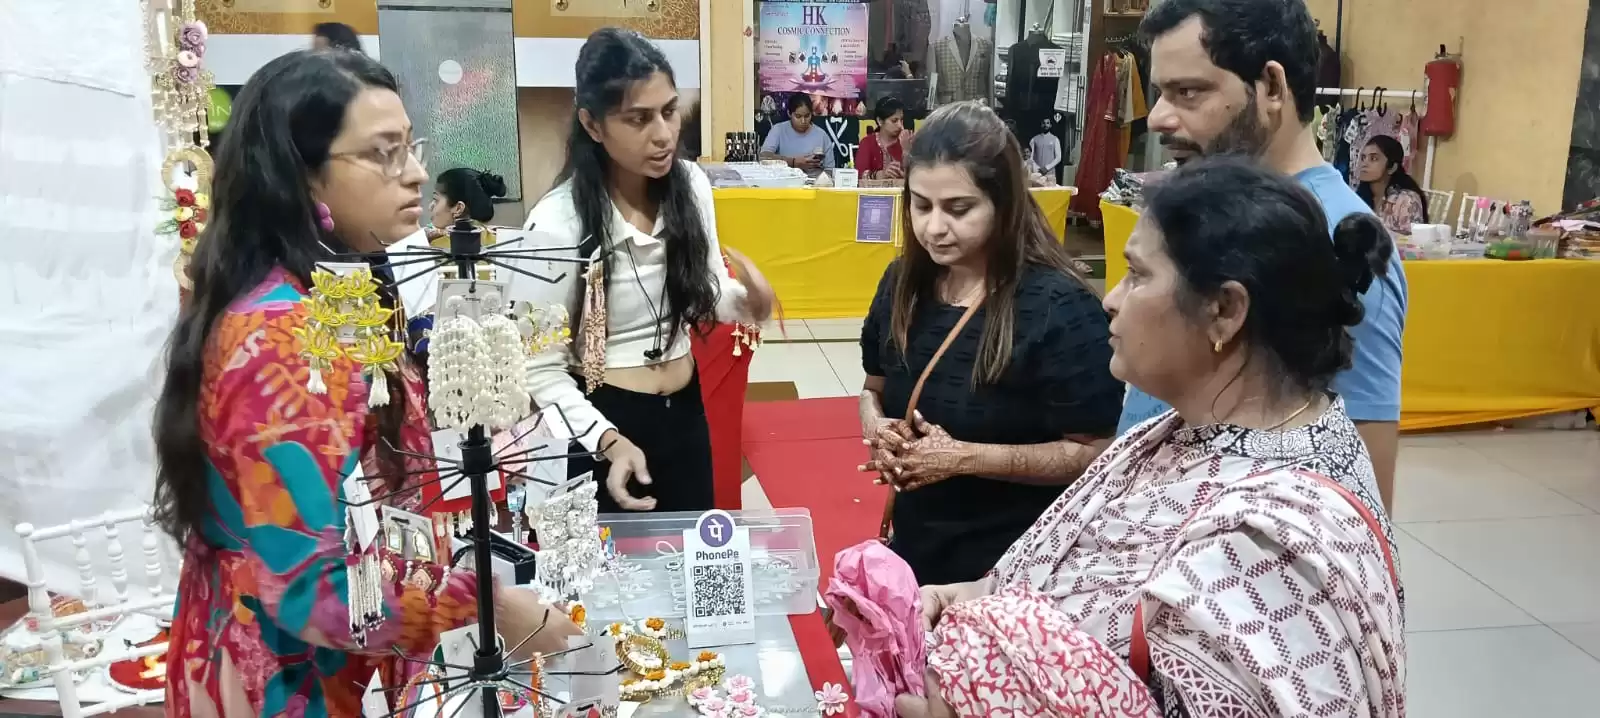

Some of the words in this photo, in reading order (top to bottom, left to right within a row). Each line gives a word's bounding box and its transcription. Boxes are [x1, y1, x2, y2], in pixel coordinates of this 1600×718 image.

[802, 5, 828, 26] HK
[777, 27, 804, 36] COSMIC
[805, 27, 851, 37] CONNECTION
[708, 518, 725, 542] पे
[695, 548, 740, 561] PhonePe
